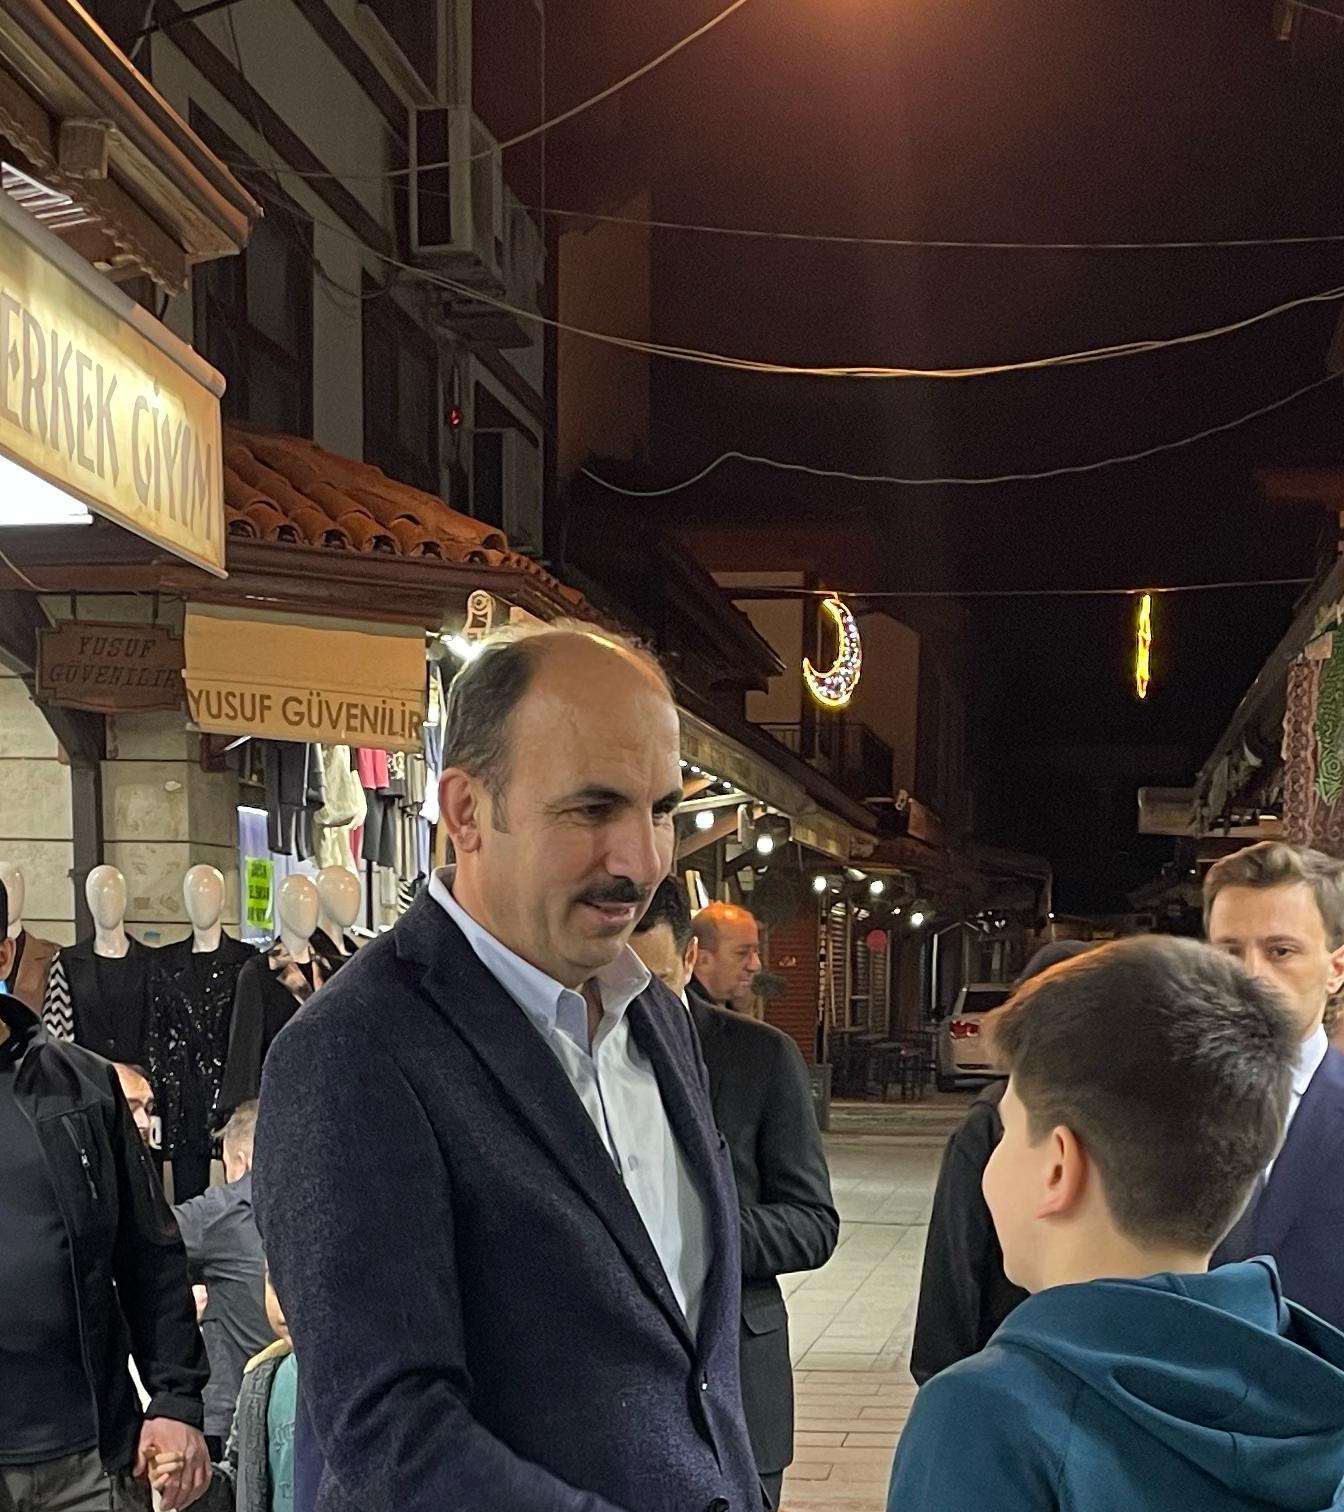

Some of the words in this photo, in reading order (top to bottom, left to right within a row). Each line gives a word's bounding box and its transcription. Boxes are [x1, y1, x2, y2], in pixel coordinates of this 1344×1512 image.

[0, 288, 119, 488] ERKEK
[77, 635, 156, 658] YUSUF
[49, 661, 181, 688] GÜVENİLİR
[186, 688, 273, 724] YUSUF
[282, 689, 422, 741] GÜVENİLİR
